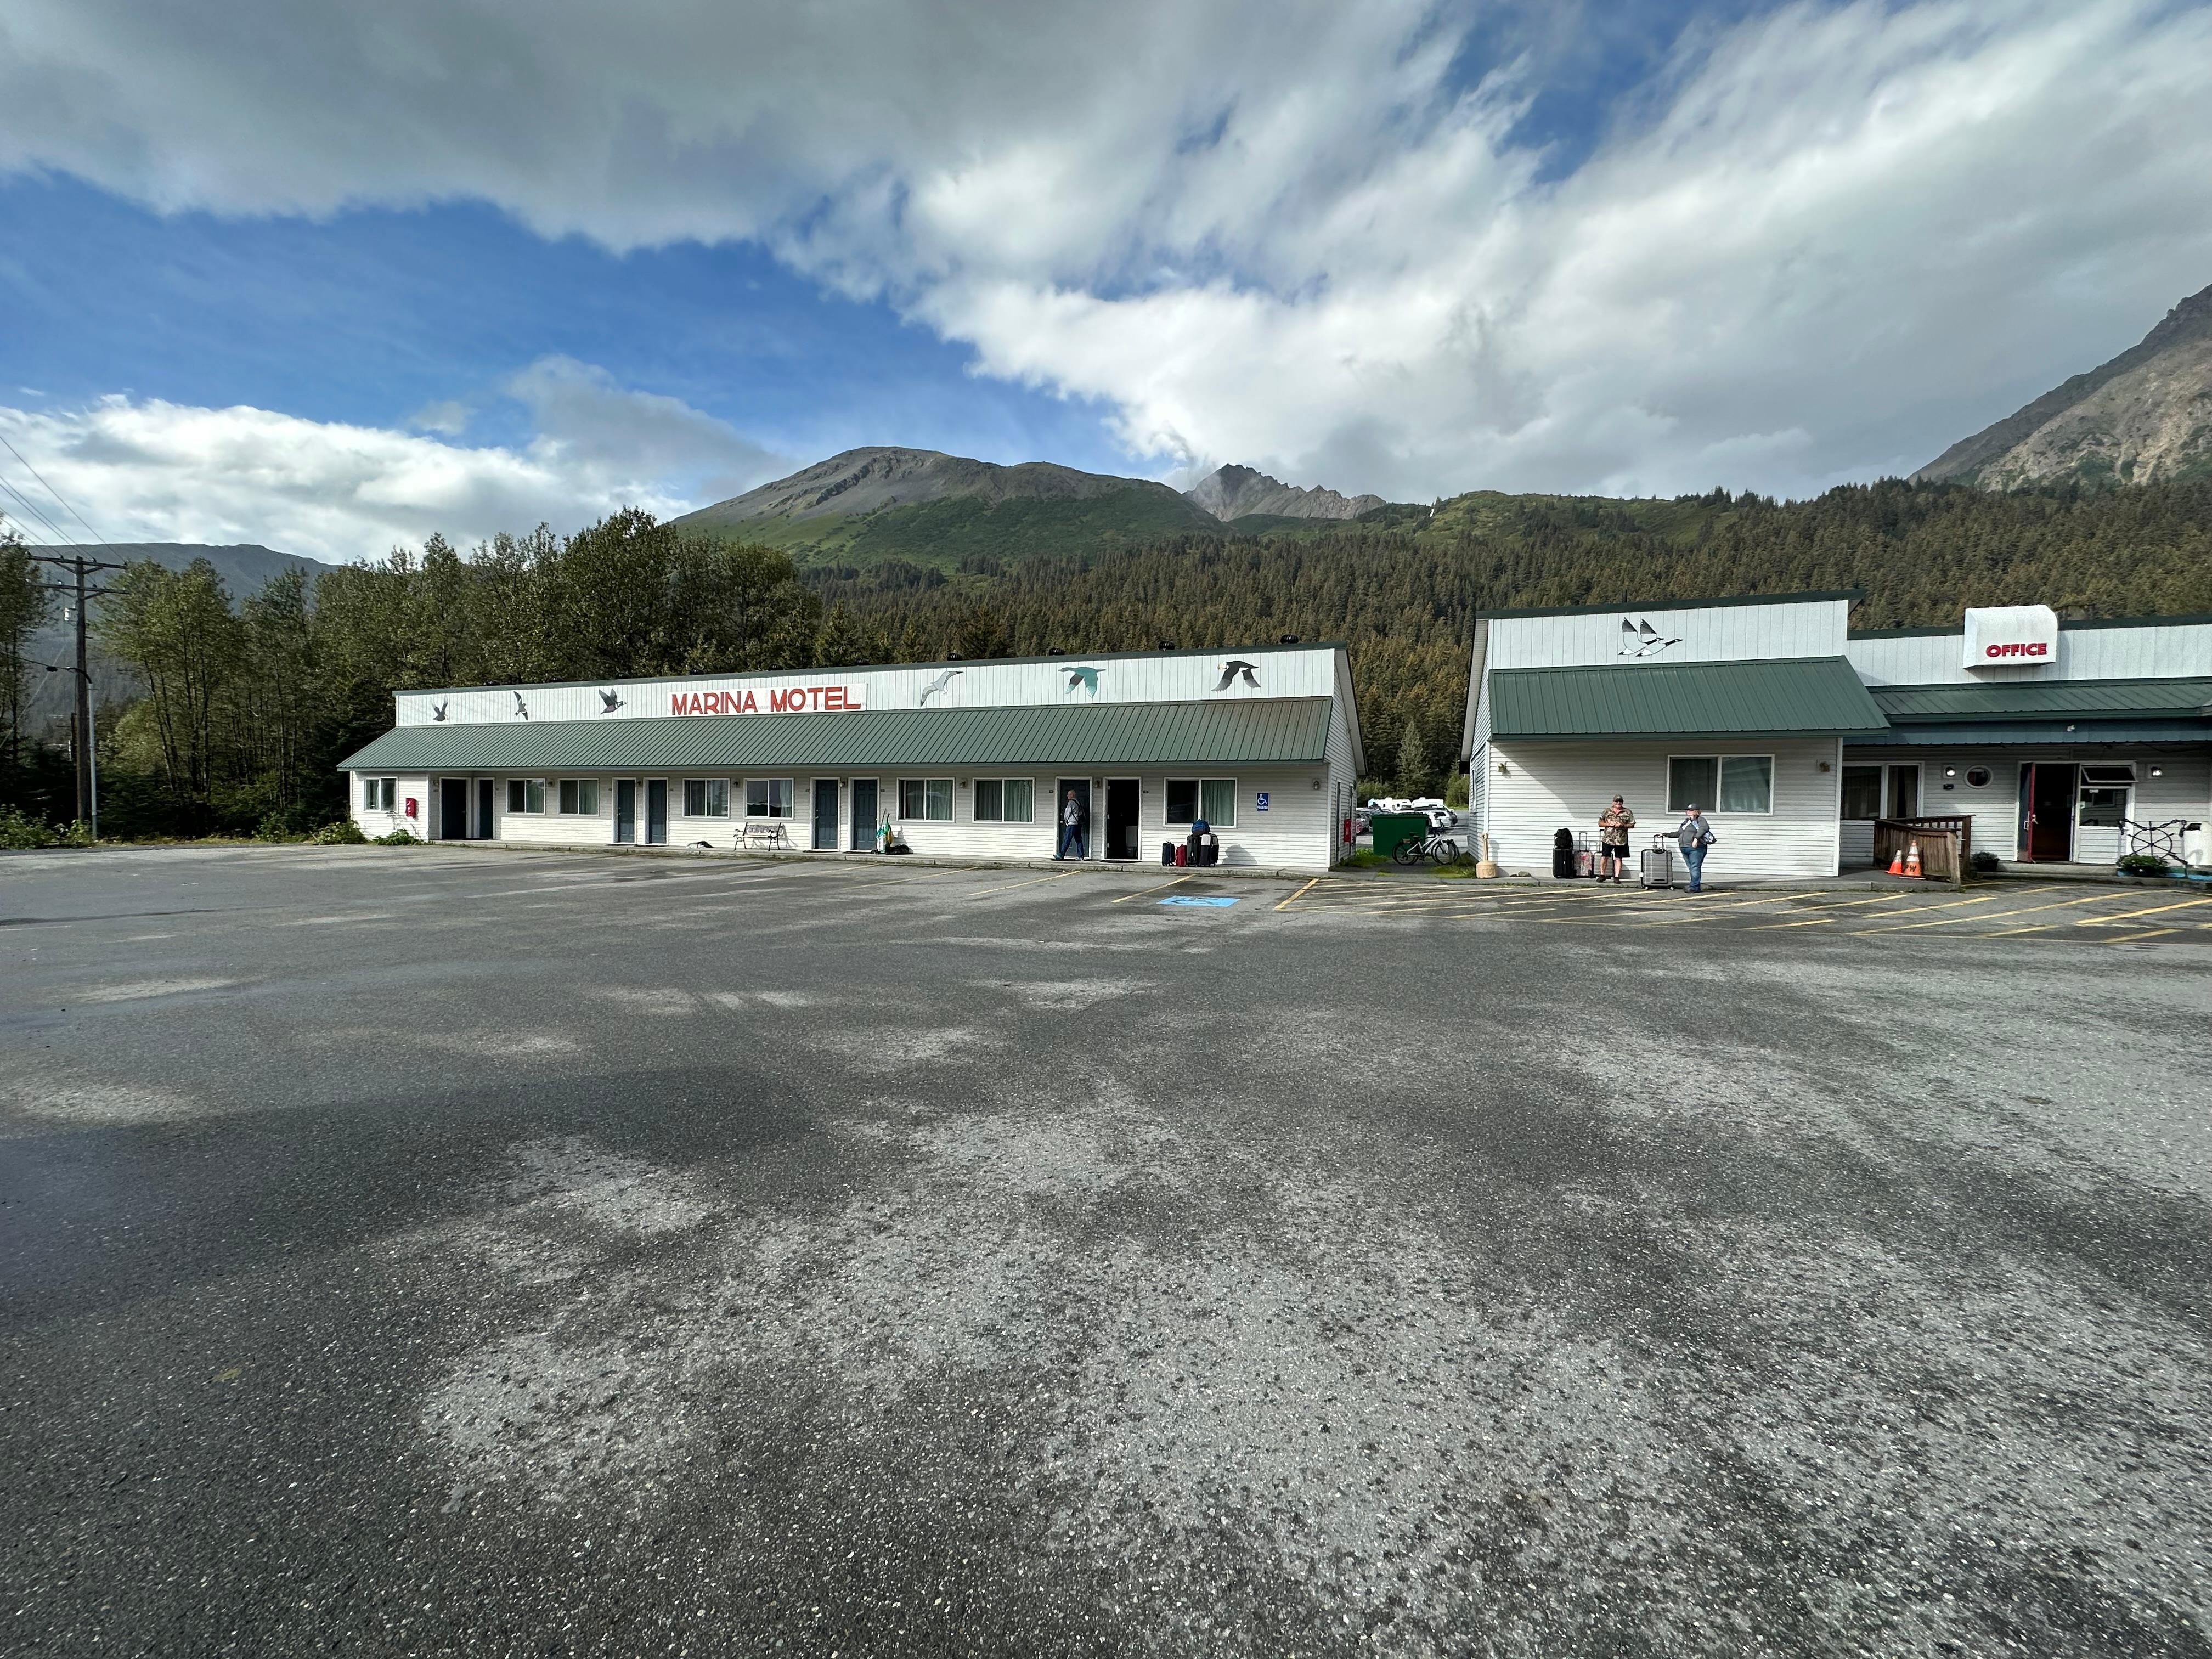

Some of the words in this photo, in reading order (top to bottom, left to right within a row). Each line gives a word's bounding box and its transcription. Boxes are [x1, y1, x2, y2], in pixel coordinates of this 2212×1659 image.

[1985, 642, 2047, 657] OFFICE
[672, 691, 758, 715] MARINA
[770, 686, 861, 712] MOTEL
